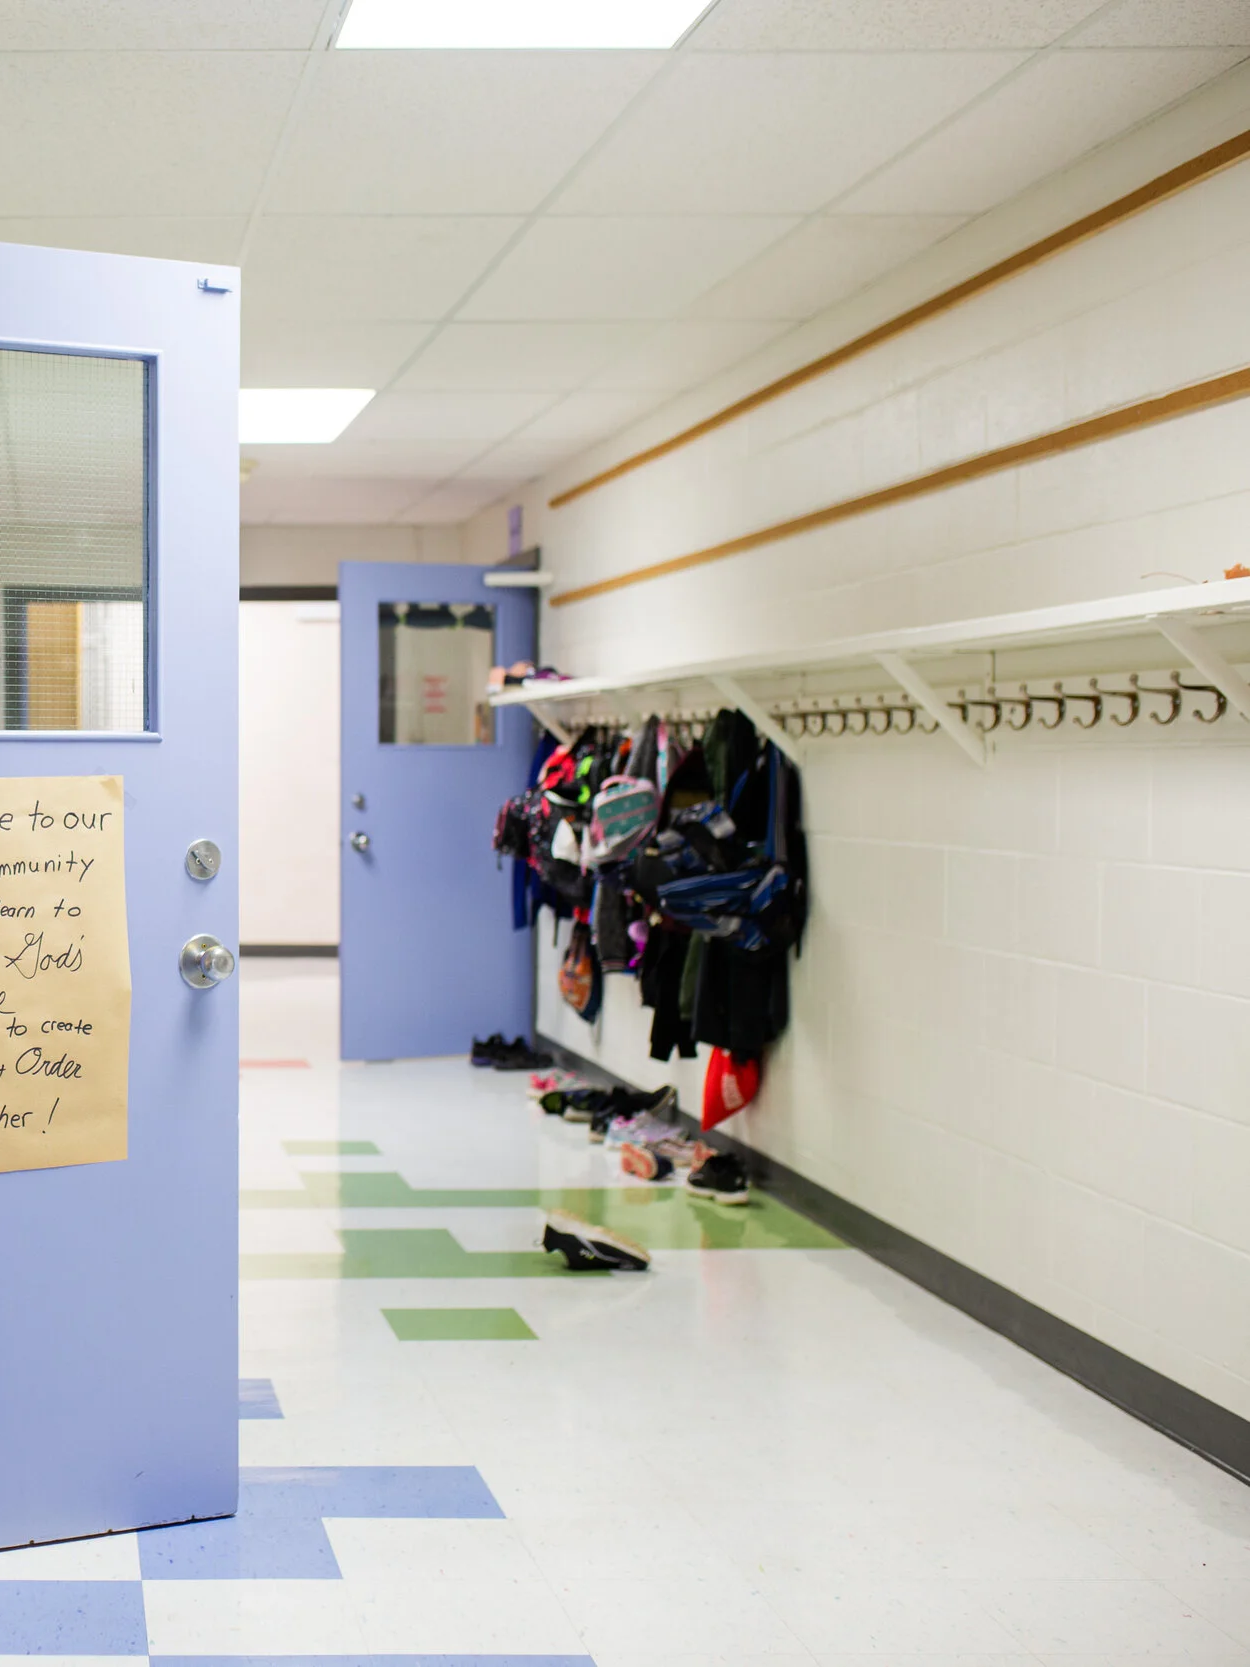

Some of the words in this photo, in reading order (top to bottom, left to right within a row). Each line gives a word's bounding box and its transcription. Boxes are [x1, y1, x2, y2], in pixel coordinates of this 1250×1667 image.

[28, 799, 55, 832] to
[63, 811, 113, 832] our
[53, 898, 82, 918] to
[5, 1016, 28, 1038] to
[40, 1018, 93, 1036] create
[15, 1046, 83, 1080] Order
